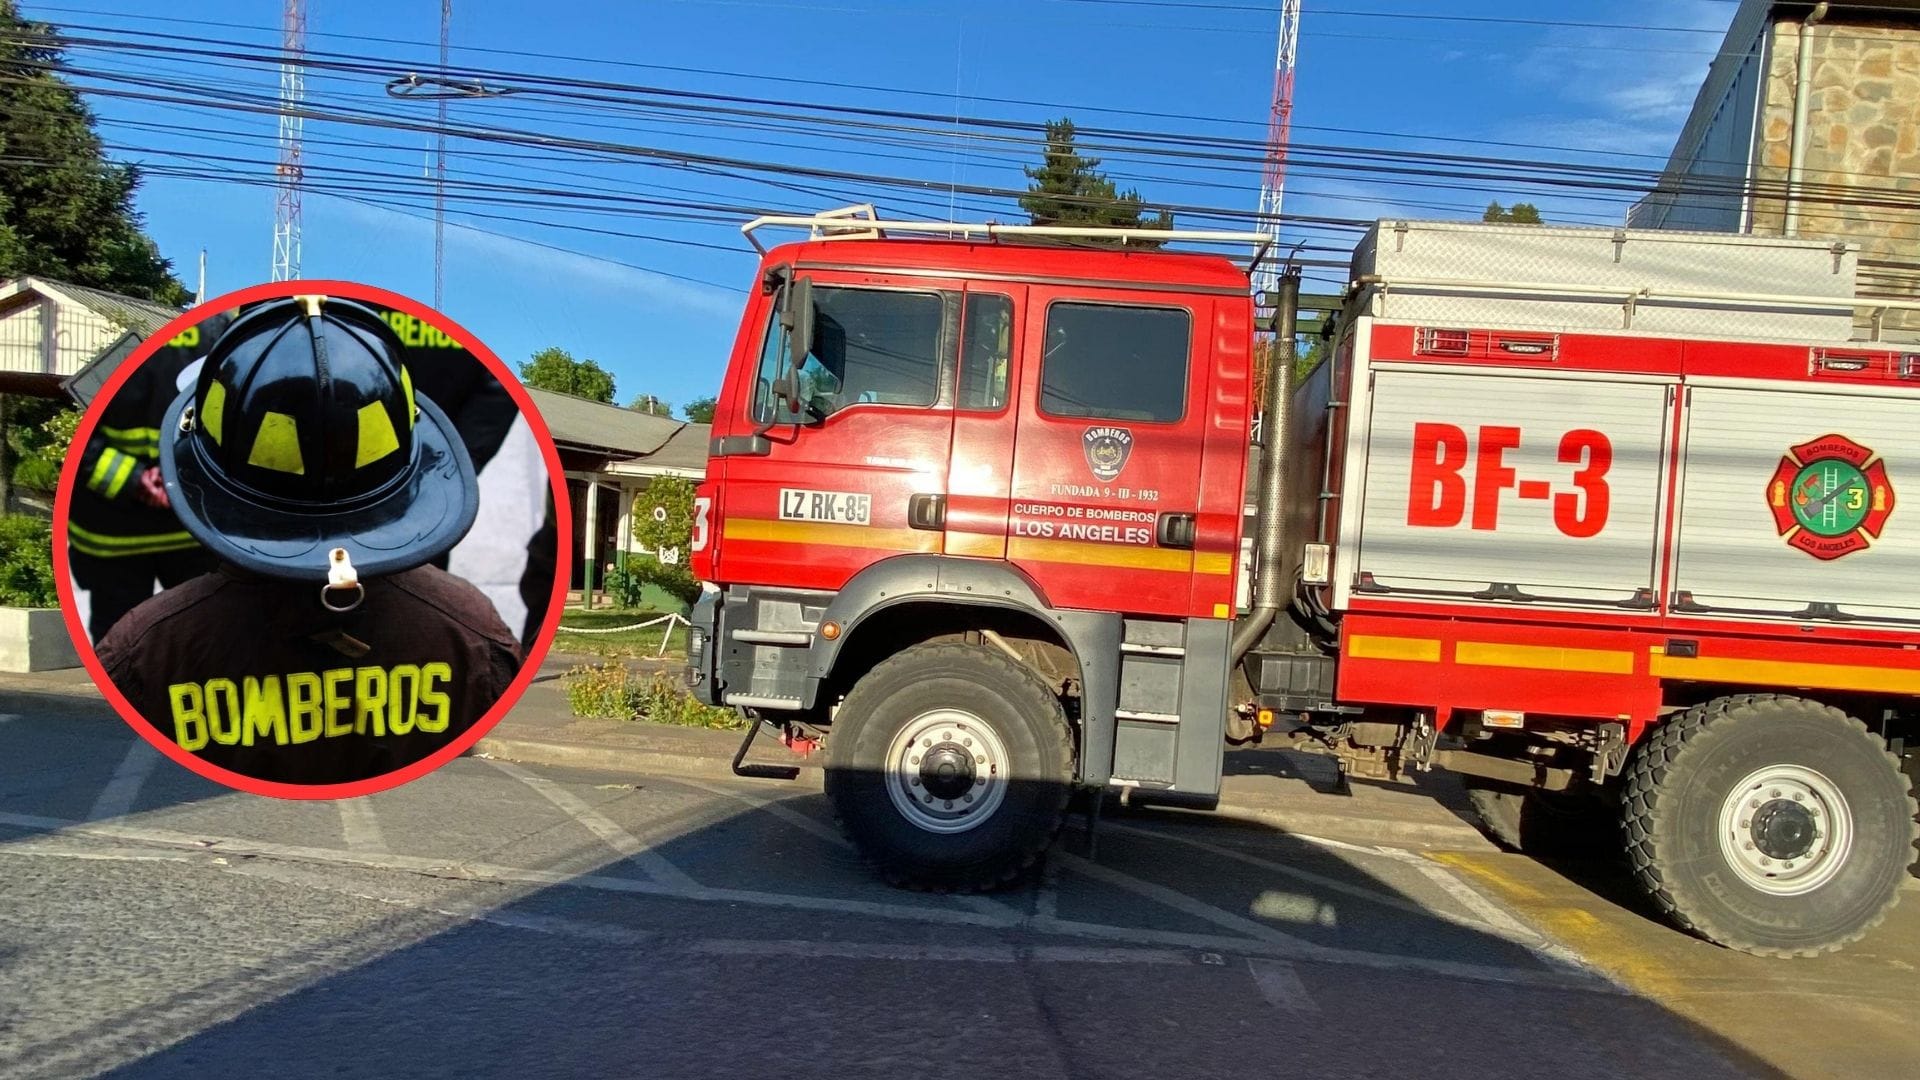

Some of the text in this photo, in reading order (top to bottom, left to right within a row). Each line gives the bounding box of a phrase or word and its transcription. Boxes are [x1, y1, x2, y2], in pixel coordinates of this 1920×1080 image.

[1085, 428, 1130, 444] BOMBEROS
[1806, 444, 1860, 458] BOMBEROS
[1051, 484, 1100, 497] FUNDADA
[1407, 422, 1613, 538] BF-3
[783, 491, 868, 523] LZ RK-85
[1847, 488, 1864, 510] 3
[692, 497, 711, 551] 3
[1014, 504, 1155, 523] CUERPO DE BOMBEROS
[1015, 519, 1150, 544] LOS ANGELES
[1800, 536, 1856, 551] LOS ANGELES
[169, 662, 452, 751] BOMBEROS
